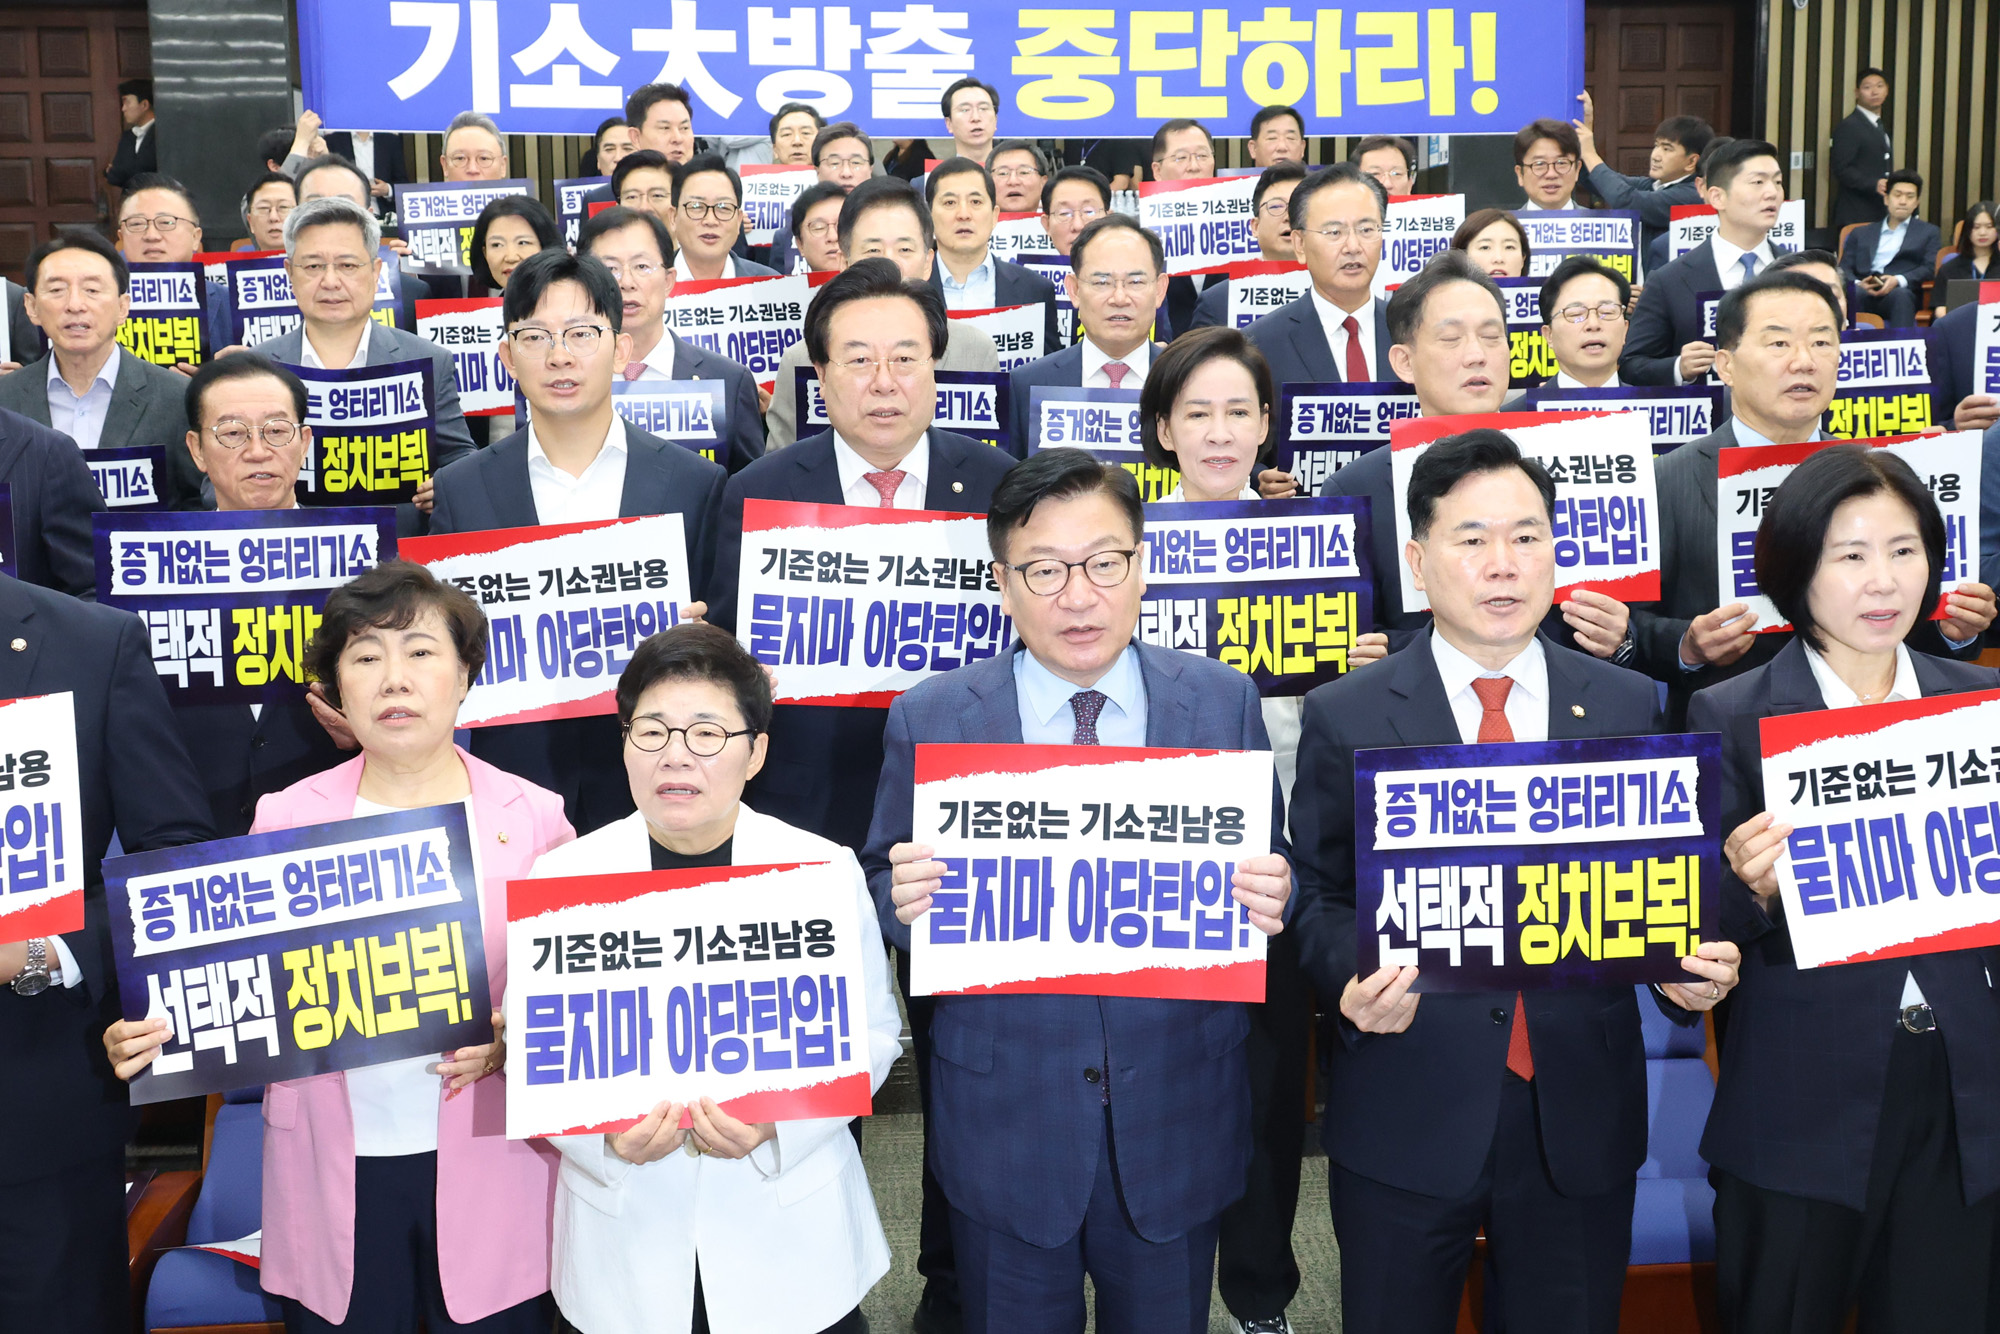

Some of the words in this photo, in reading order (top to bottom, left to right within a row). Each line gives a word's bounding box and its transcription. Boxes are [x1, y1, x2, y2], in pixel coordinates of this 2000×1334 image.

[1011, 5, 1499, 121] 중단하라!
[408, 194, 458, 218] 증거없는
[747, 183, 790, 196] 기준없는
[1149, 202, 1198, 218] 기준없는
[1202, 198, 1255, 215] 기소권남
[1396, 216, 1455, 232] 기소권남용
[1524, 223, 1566, 243] 거없는
[1571, 222, 1629, 243] 엉터리기소
[407, 228, 458, 268] 선택적
[129, 277, 193, 303] 터리기소
[243, 274, 299, 303] 증거없
[1240, 288, 1299, 305] 기준없는
[430, 325, 491, 346] 기준없는
[664, 307, 724, 327] 기준없는
[729, 302, 802, 323] 기소권남용
[328, 381, 421, 420] 엉터리기소
[1298, 402, 1371, 434] 증거없는
[1047, 408, 1122, 443] 증거없는
[322, 428, 430, 493] 정치보복!
[1530, 454, 1637, 484] 소권남용
[120, 540, 230, 586] 증거없는
[239, 534, 373, 583] 엉터리기소
[760, 548, 869, 584] 기준없는
[1225, 524, 1350, 573] 엉터리기소
[538, 558, 669, 597] 기소권남용
[138, 608, 224, 688] 택적
[750, 593, 854, 667] 묻지마
[1217, 591, 1358, 676] 정치보복!
[1386, 779, 1516, 837] 증거없는
[1527, 770, 1691, 833] 엉터리기소
[1788, 758, 1916, 807] 기준없는
[938, 800, 1070, 840] 기준없는
[1080, 802, 1245, 845] 기소권남용
[1787, 813, 1918, 916] 묻지마
[140, 871, 276, 942] 증거없는
[283, 841, 447, 917] 엉터리기소
[929, 855, 1054, 944] 묻지마
[1375, 864, 1504, 967] 선택적
[1517, 855, 1700, 966] 정치보복!
[532, 930, 662, 975] 기준없는
[673, 919, 835, 965] 기소권남용
[145, 954, 280, 1076] 선택적
[282, 921, 473, 1051] 정치보복!
[525, 986, 653, 1085] 묻지마
[666, 974, 851, 1075] 야당탄압!
